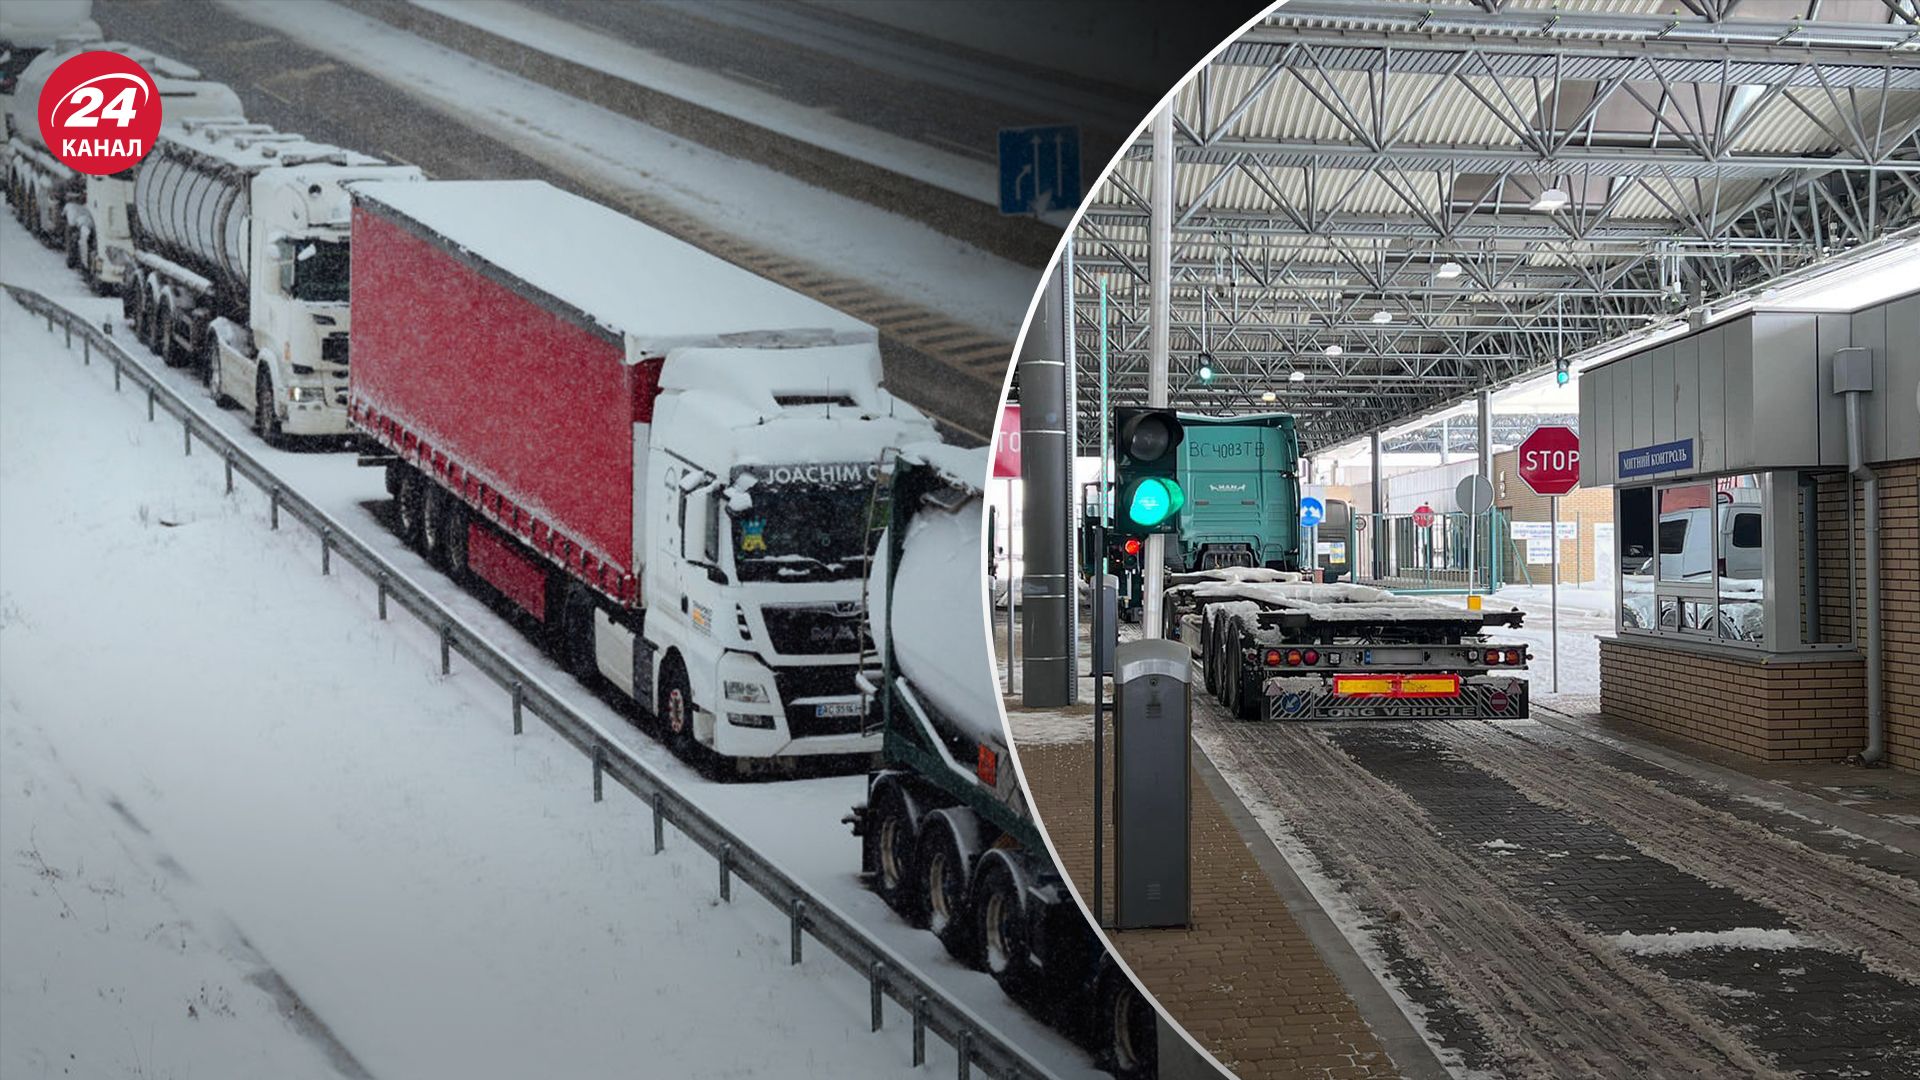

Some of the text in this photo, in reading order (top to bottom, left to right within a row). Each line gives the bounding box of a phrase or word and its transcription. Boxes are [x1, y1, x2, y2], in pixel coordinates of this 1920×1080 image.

[1526, 450, 1580, 471] STOP
[1623, 448, 1687, 471] МИТНИЙ КОНТРОЛЬ
[766, 465, 862, 485] JOACHIM
[1315, 707, 1476, 717] LONG VEHICLE
